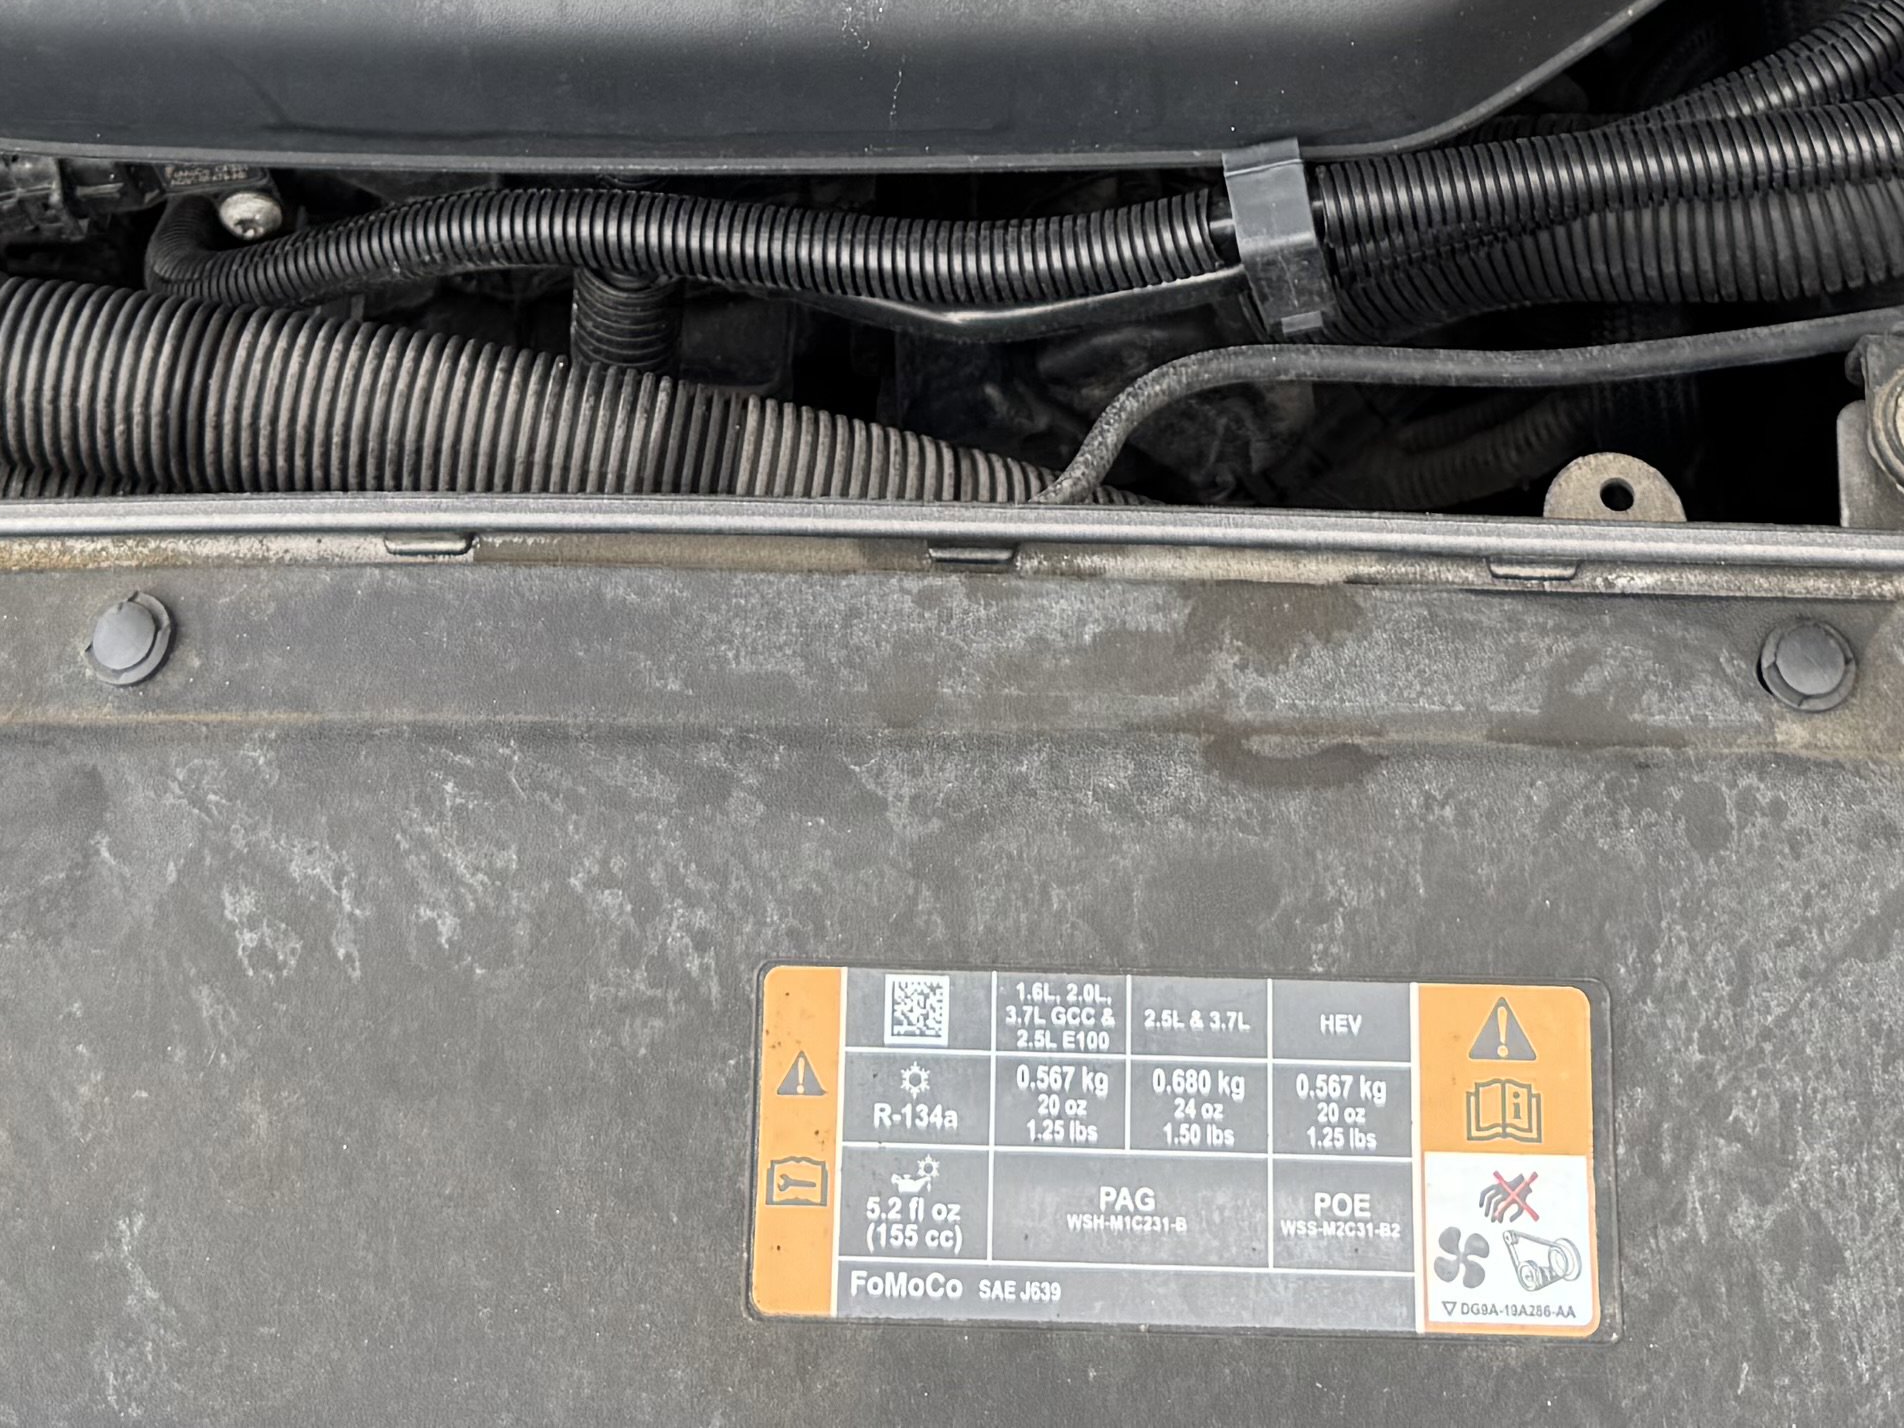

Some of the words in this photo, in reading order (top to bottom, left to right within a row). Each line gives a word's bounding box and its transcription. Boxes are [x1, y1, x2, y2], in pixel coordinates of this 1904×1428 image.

[1016, 981, 1061, 1004] 1.6L,
[1066, 982, 1112, 1004] 2.0L,
[1005, 1005, 1046, 1025] 3.7L
[1051, 1006, 1096, 1026] GCC
[1100, 1007, 1116, 1026] &
[1144, 1008, 1185, 1031] 2.5L
[1189, 1009, 1204, 1030] &
[1209, 1010, 1251, 1032] 3.7L
[1319, 1013, 1363, 1036] HEV
[1016, 1029, 1058, 1049] 2.5L
[1062, 1030, 1110, 1050] E100
[1016, 1064, 1076, 1092] 0.567
[1081, 1065, 1110, 1099] kg
[1152, 1067, 1212, 1095] 0.680
[1217, 1069, 1246, 1103] kg
[1295, 1072, 1354, 1100] 0.567
[1359, 1074, 1388, 1107] kg
[873, 1102, 959, 1130] R-134a
[1037, 1093, 1061, 1116] 20
[1064, 1098, 1088, 1116] oz
[1173, 1097, 1197, 1119] 24
[1200, 1102, 1224, 1120] oz
[1317, 1101, 1340, 1124] 20
[1343, 1106, 1367, 1124] oz
[1026, 1118, 1065, 1142] 1.25
[1069, 1119, 1098, 1142] lbs
[1162, 1122, 1202, 1146] 1.50
[1206, 1123, 1235, 1147] lbs
[1306, 1125, 1345, 1150] 1.25
[1349, 1127, 1378, 1151] lbs
[865, 1196, 903, 1222] 5.2
[908, 1196, 925, 1223] fl
[930, 1201, 961, 1222] oz
[1098, 1185, 1156, 1213] PAG
[1313, 1191, 1373, 1219] POE
[1066, 1212, 1188, 1234] WSH-M1C231-B
[1279, 1218, 1402, 1240] WSS-M2C31-B2
[866, 1222, 920, 1254] (155
[924, 1224, 964, 1256] cc)
[849, 1269, 964, 1300] FoMoCo
[978, 1278, 1017, 1301] SAE
[1020, 1280, 1063, 1302] J639
[1459, 1301, 1578, 1319] DG9A-19A286-AA
